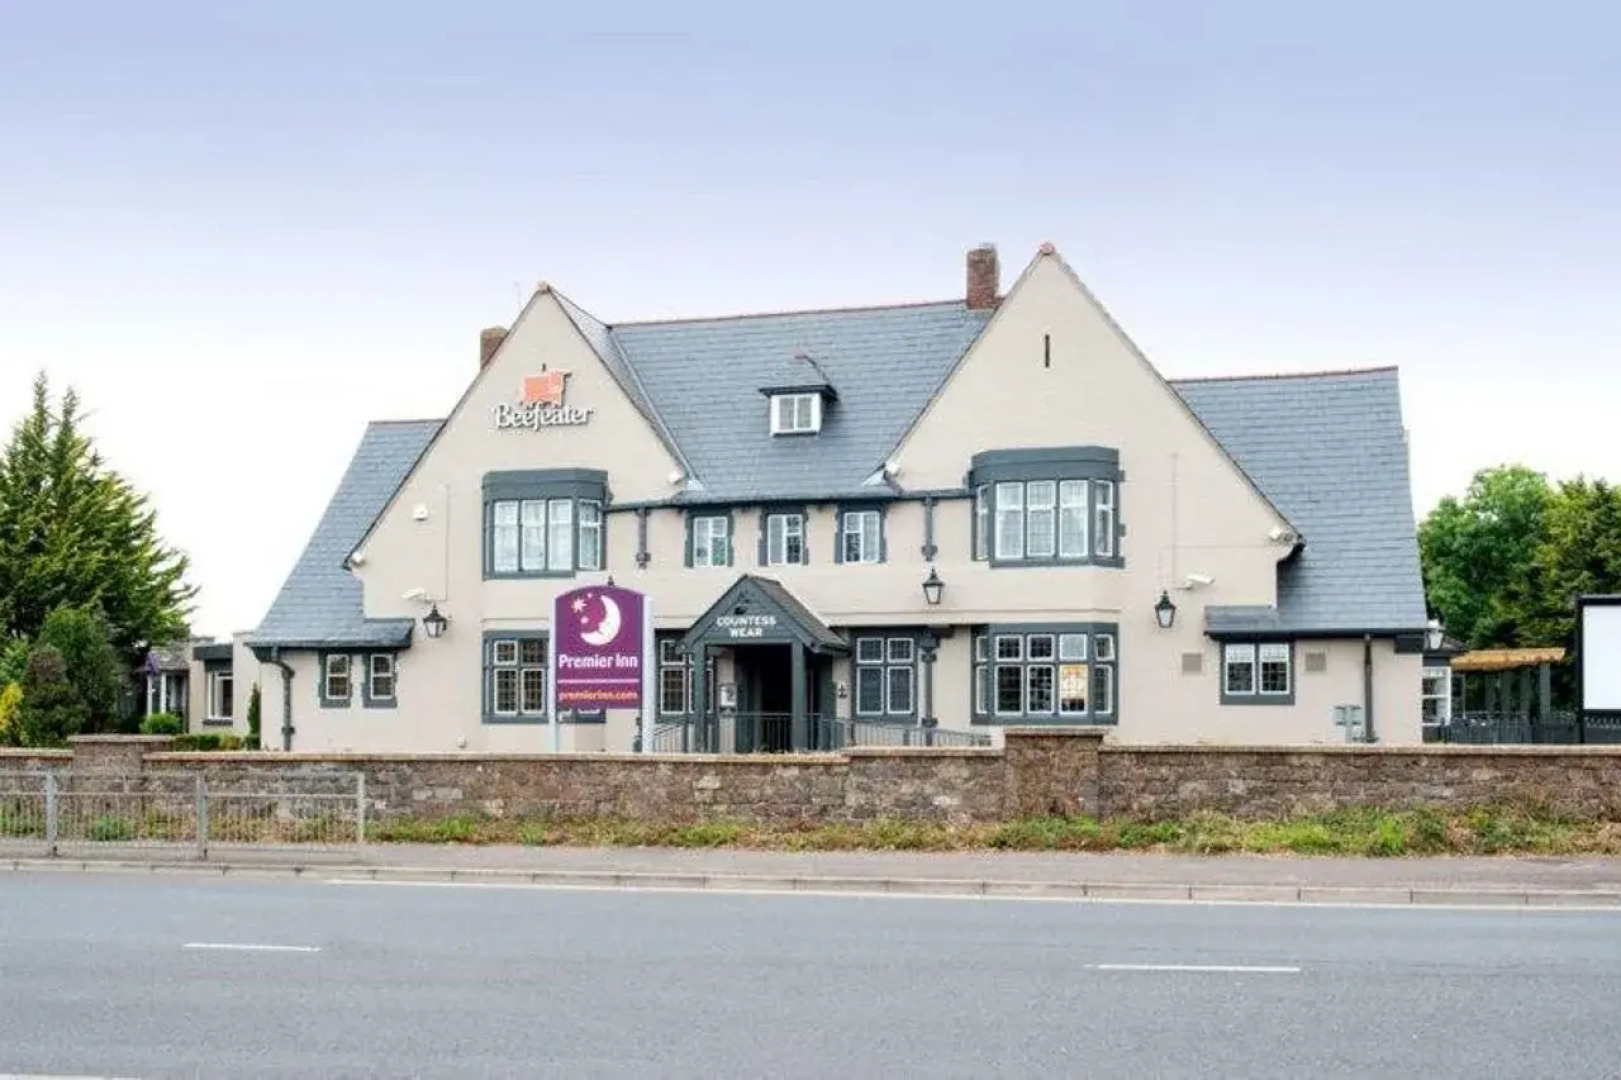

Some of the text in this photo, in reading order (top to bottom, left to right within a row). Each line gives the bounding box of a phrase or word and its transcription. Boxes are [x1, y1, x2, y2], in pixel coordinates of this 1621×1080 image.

[491, 404, 594, 431] Beefeater
[717, 615, 776, 627] COUNTESS
[729, 627, 762, 638] WEAR
[559, 653, 638, 668] Premier Inn
[558, 690, 638, 702] premierinn.com
